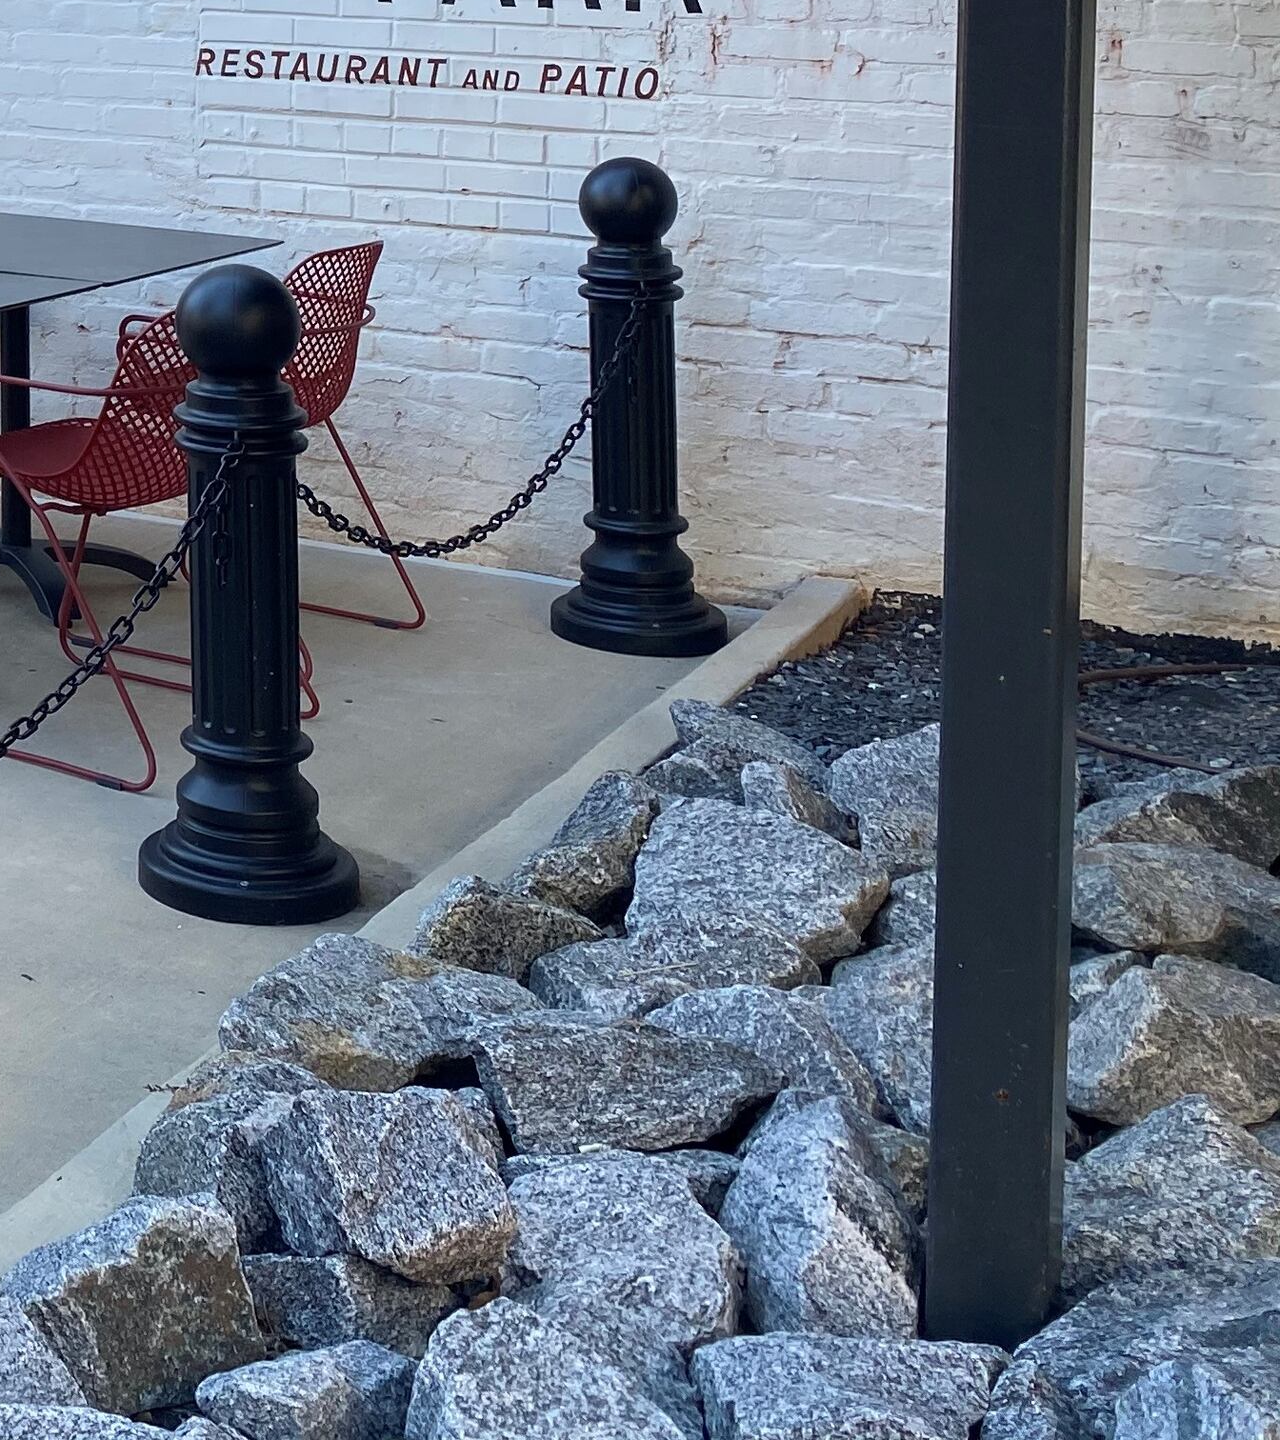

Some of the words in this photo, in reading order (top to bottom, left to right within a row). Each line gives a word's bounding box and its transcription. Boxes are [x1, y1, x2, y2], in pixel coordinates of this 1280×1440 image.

[195, 47, 448, 89] RESTAURANT
[463, 68, 521, 92] AND
[538, 62, 659, 101] PATIO
